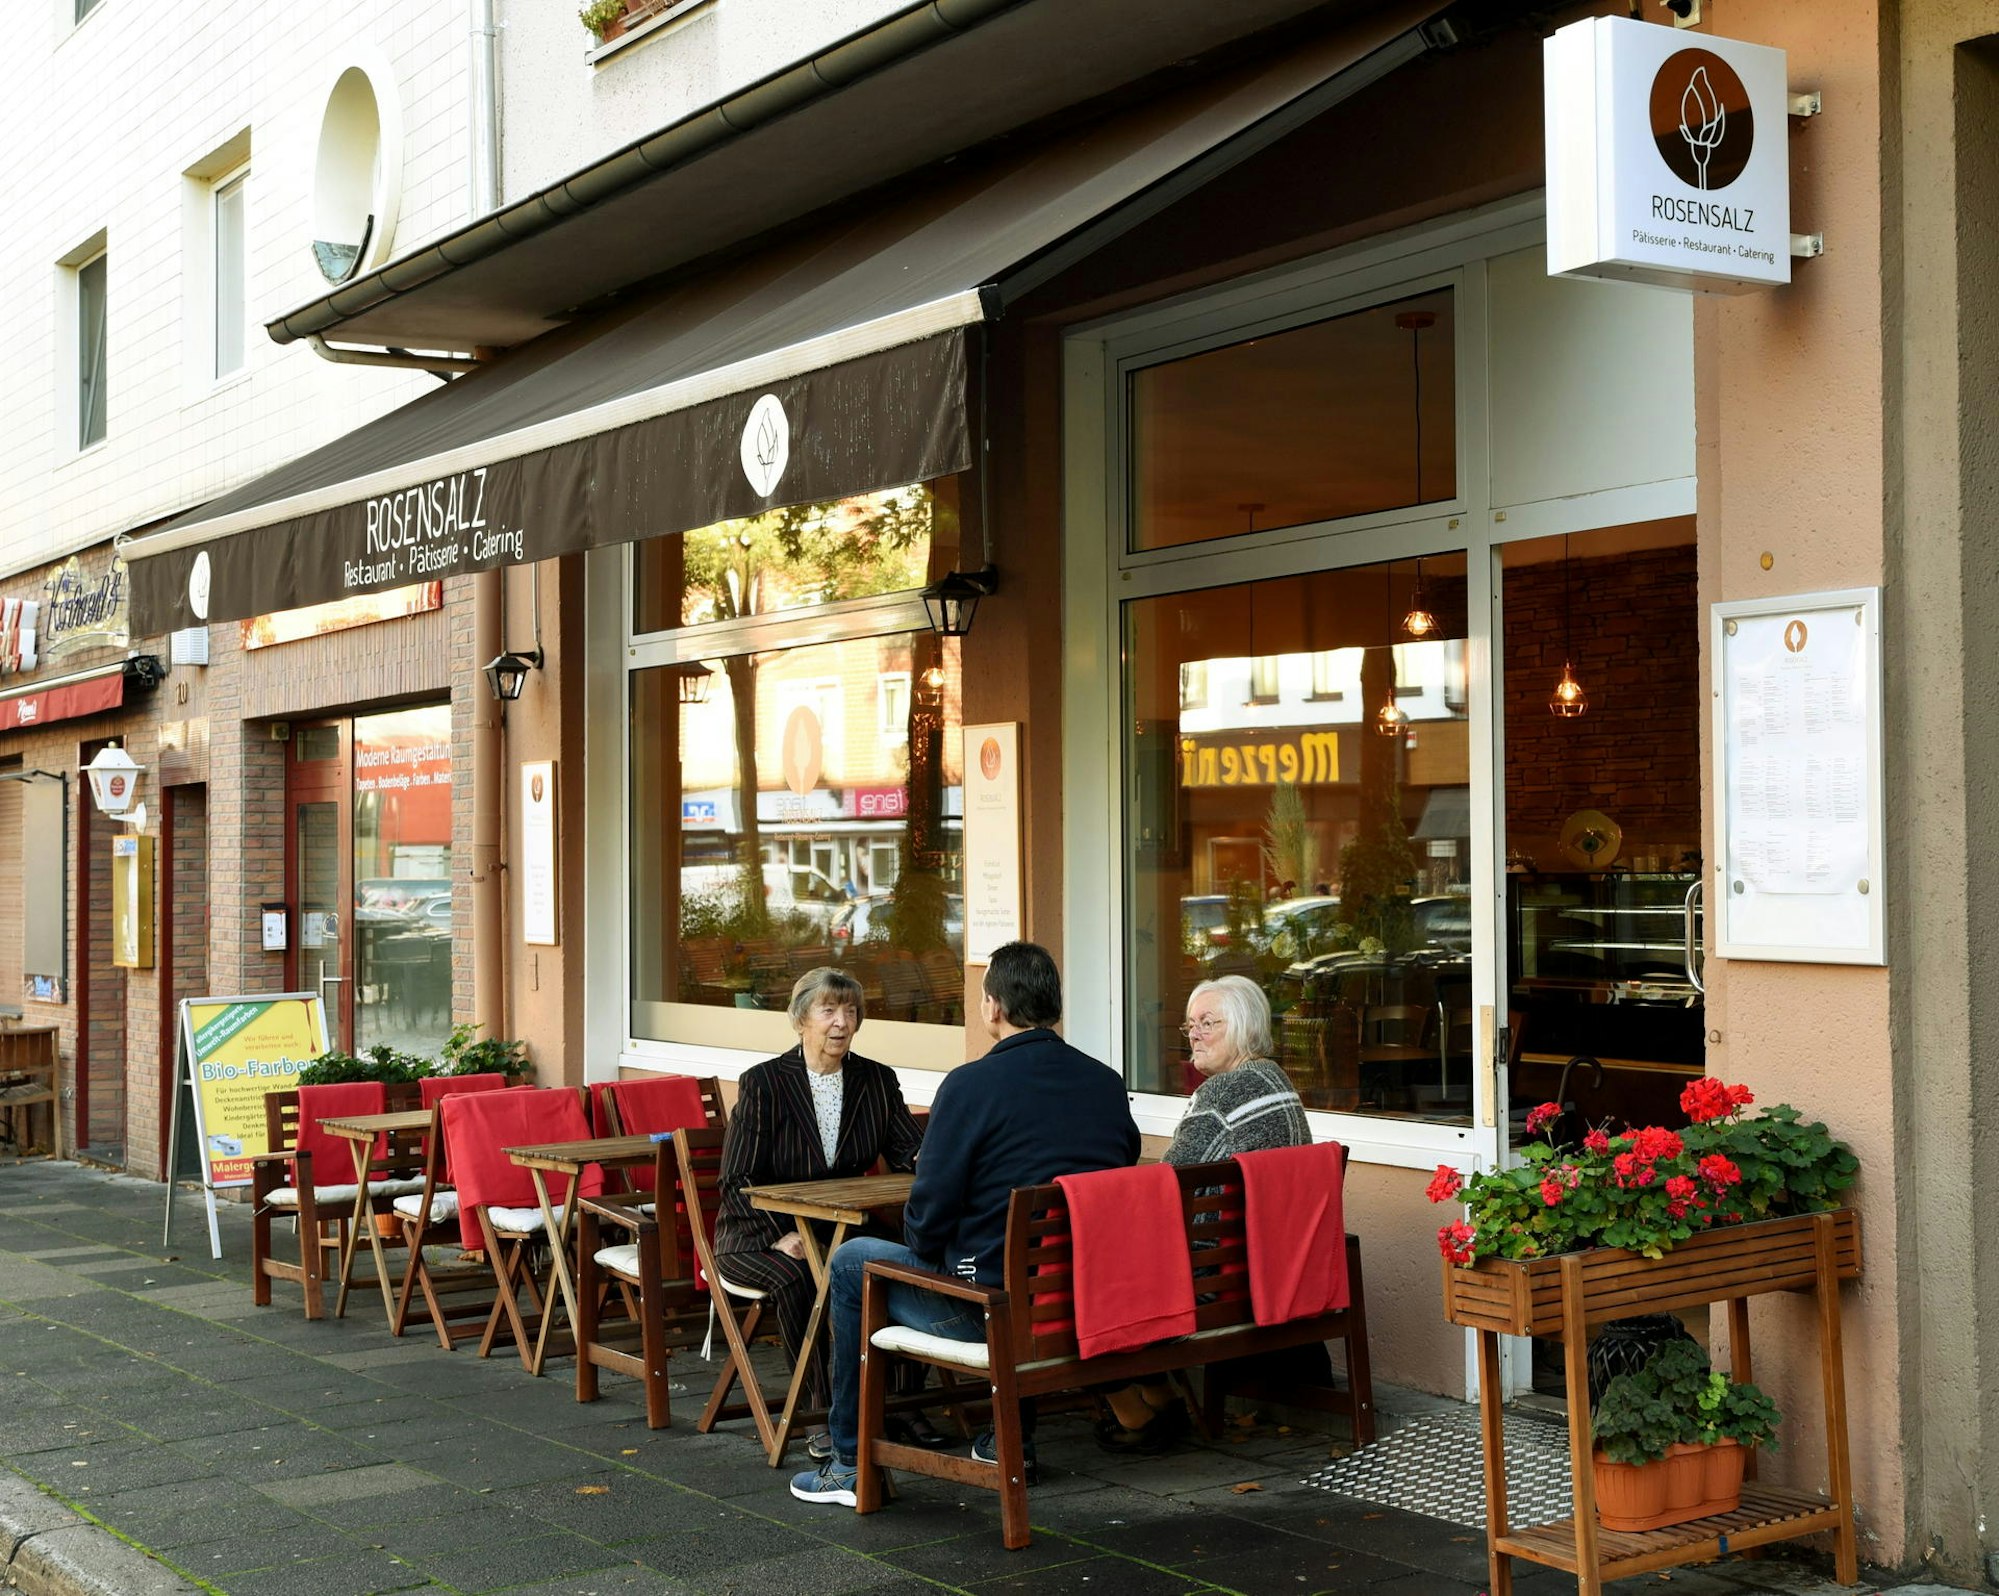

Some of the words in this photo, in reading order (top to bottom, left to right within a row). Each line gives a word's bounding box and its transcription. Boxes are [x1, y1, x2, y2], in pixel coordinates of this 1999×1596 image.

[1652, 195, 1754, 233] ROSENSALZ
[1633, 229, 1676, 248] Pâtisserie
[1683, 236, 1732, 256] Restaurant
[1738, 245, 1775, 265] Catering
[367, 467, 487, 555] ROSENSALZ
[344, 553, 397, 588] Restaurant
[408, 537, 459, 575] Pâtisserie
[472, 524, 525, 561] Catering
[357, 747, 390, 768] Moderne
[357, 777, 376, 791] Tapeten
[378, 772, 410, 791] Bodenbeläge
[412, 771, 431, 786] Farben
[216, 1087, 227, 1095] Für
[229, 1084, 271, 1093] hochwertige
